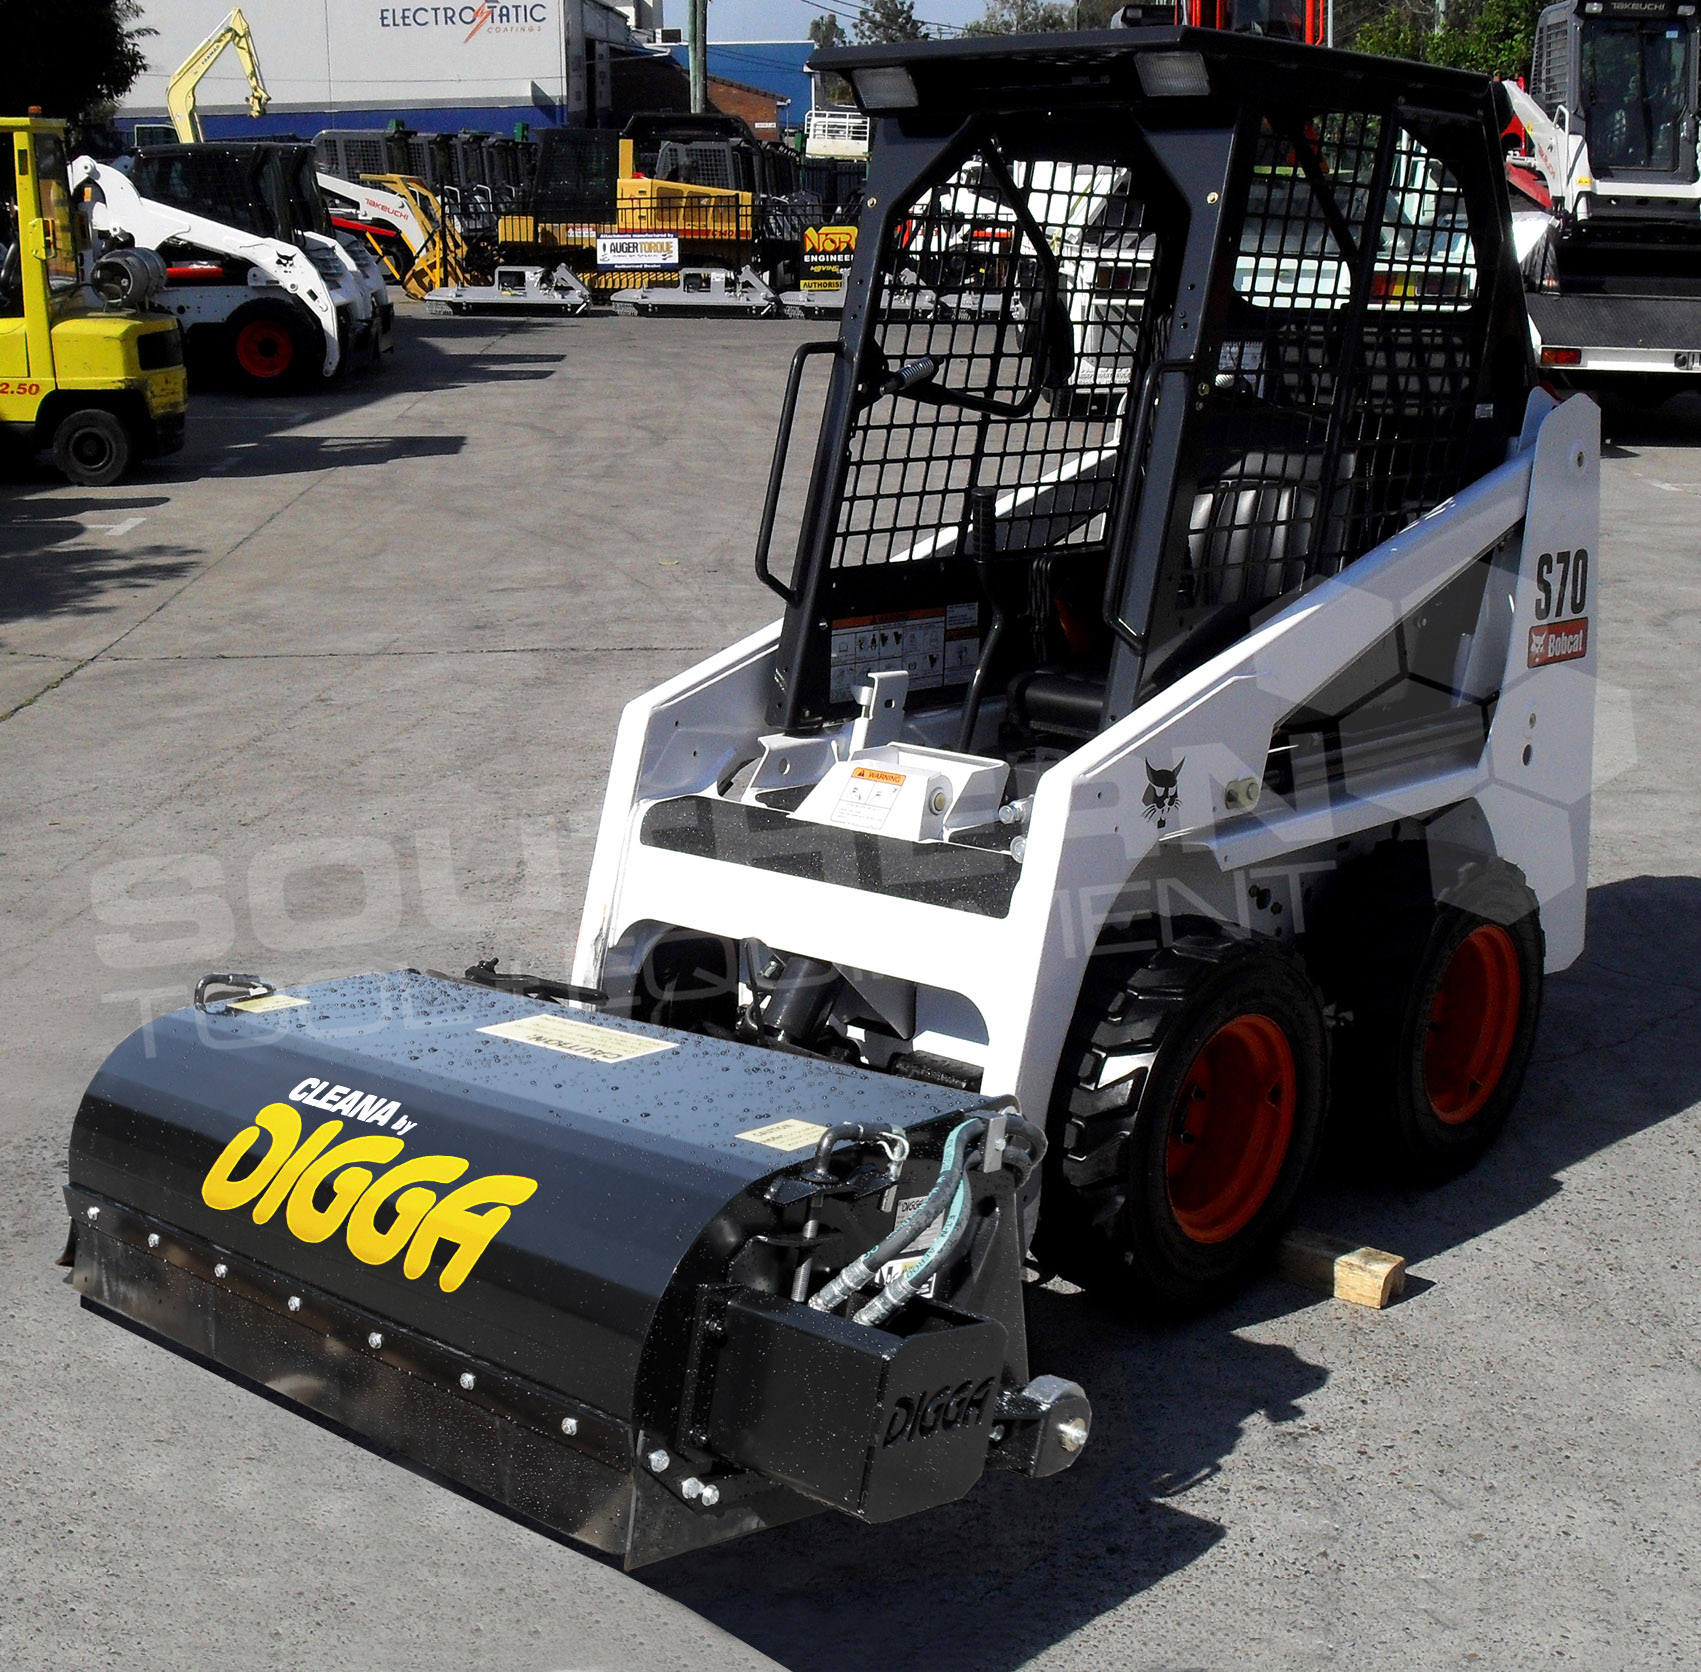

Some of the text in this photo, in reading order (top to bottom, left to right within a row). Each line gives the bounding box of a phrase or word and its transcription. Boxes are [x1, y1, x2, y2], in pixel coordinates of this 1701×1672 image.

[1535, 548, 1588, 621] S70
[1547, 630, 1583, 658] Bobcat
[868, 771, 902, 783] WARNING
[288, 1077, 418, 1136] CLEANA by
[201, 1102, 538, 1293] DIGGA
[882, 1376, 996, 1450] DIGGA
